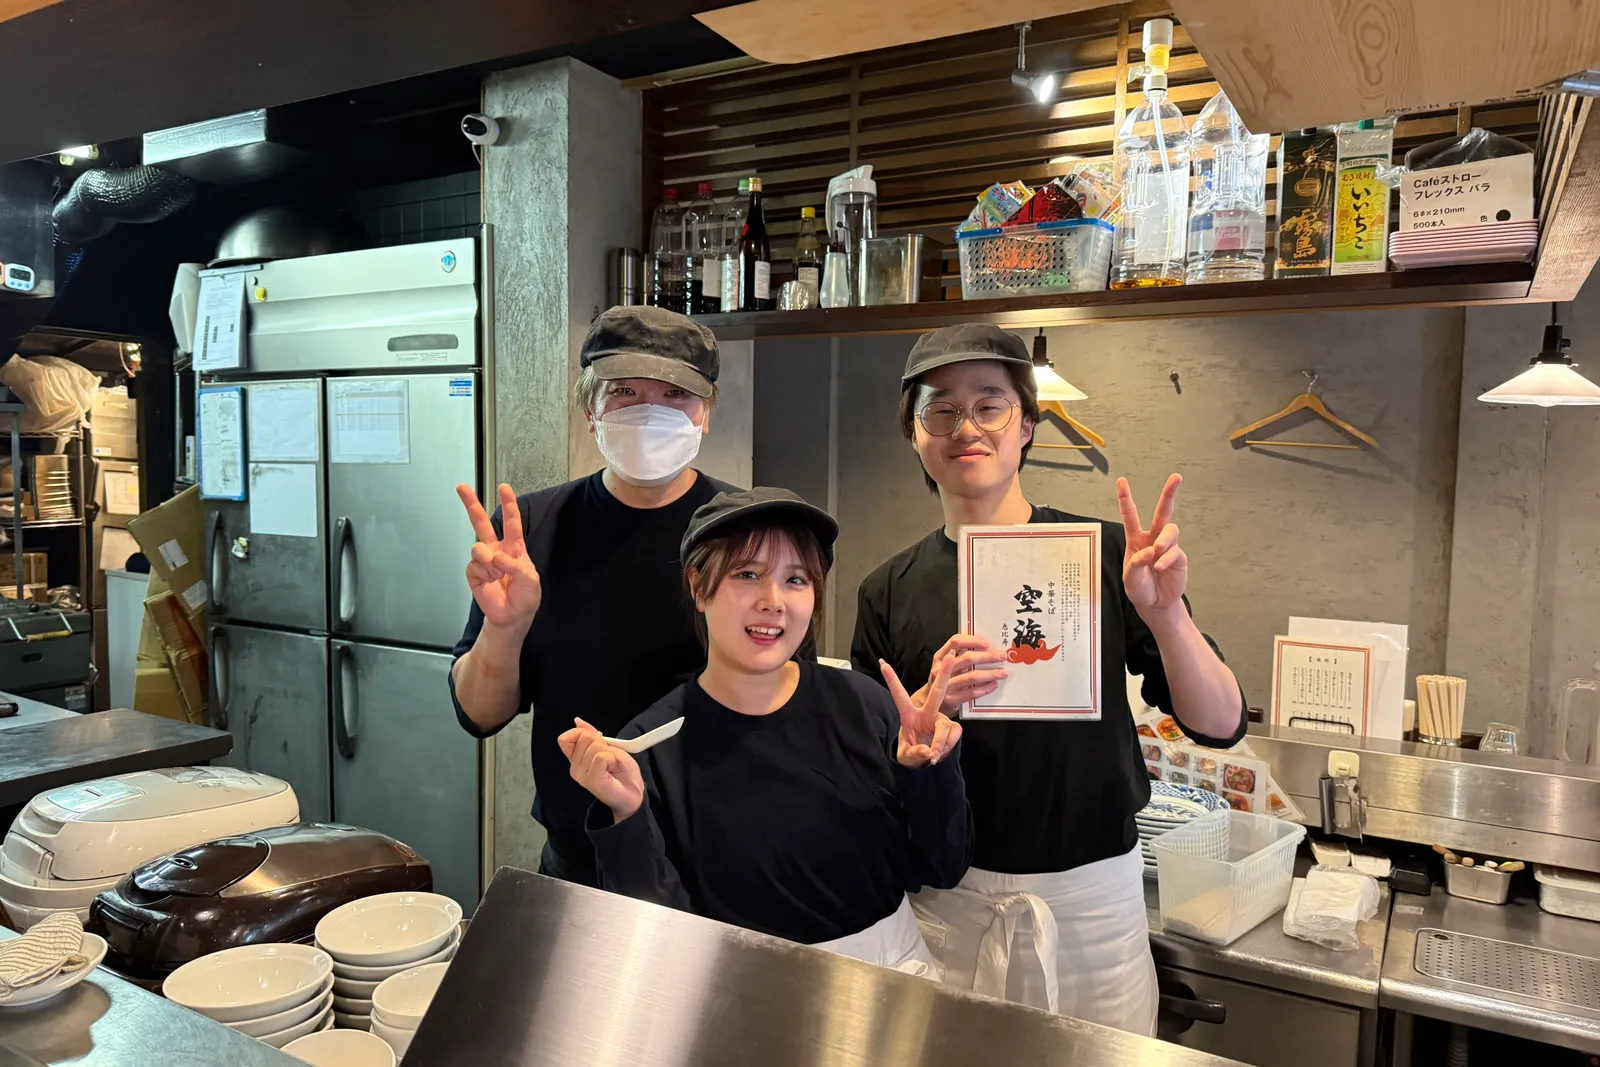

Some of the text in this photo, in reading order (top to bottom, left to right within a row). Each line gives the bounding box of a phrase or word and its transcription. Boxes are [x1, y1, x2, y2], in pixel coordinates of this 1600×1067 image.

[1413, 174, 1481, 188] Caféストロー
[1414, 182, 1491, 200] フレックス バラ
[1351, 186, 1371, 250] いいちこ
[1413, 220, 1446, 229] 500本入
[1480, 215, 1488, 223] 色
[1293, 208, 1321, 259] 霧島
[1047, 581, 1057, 615] 中華そば
[1013, 584, 1046, 650] 空海
[1001, 623, 1009, 646] 恵比寿
